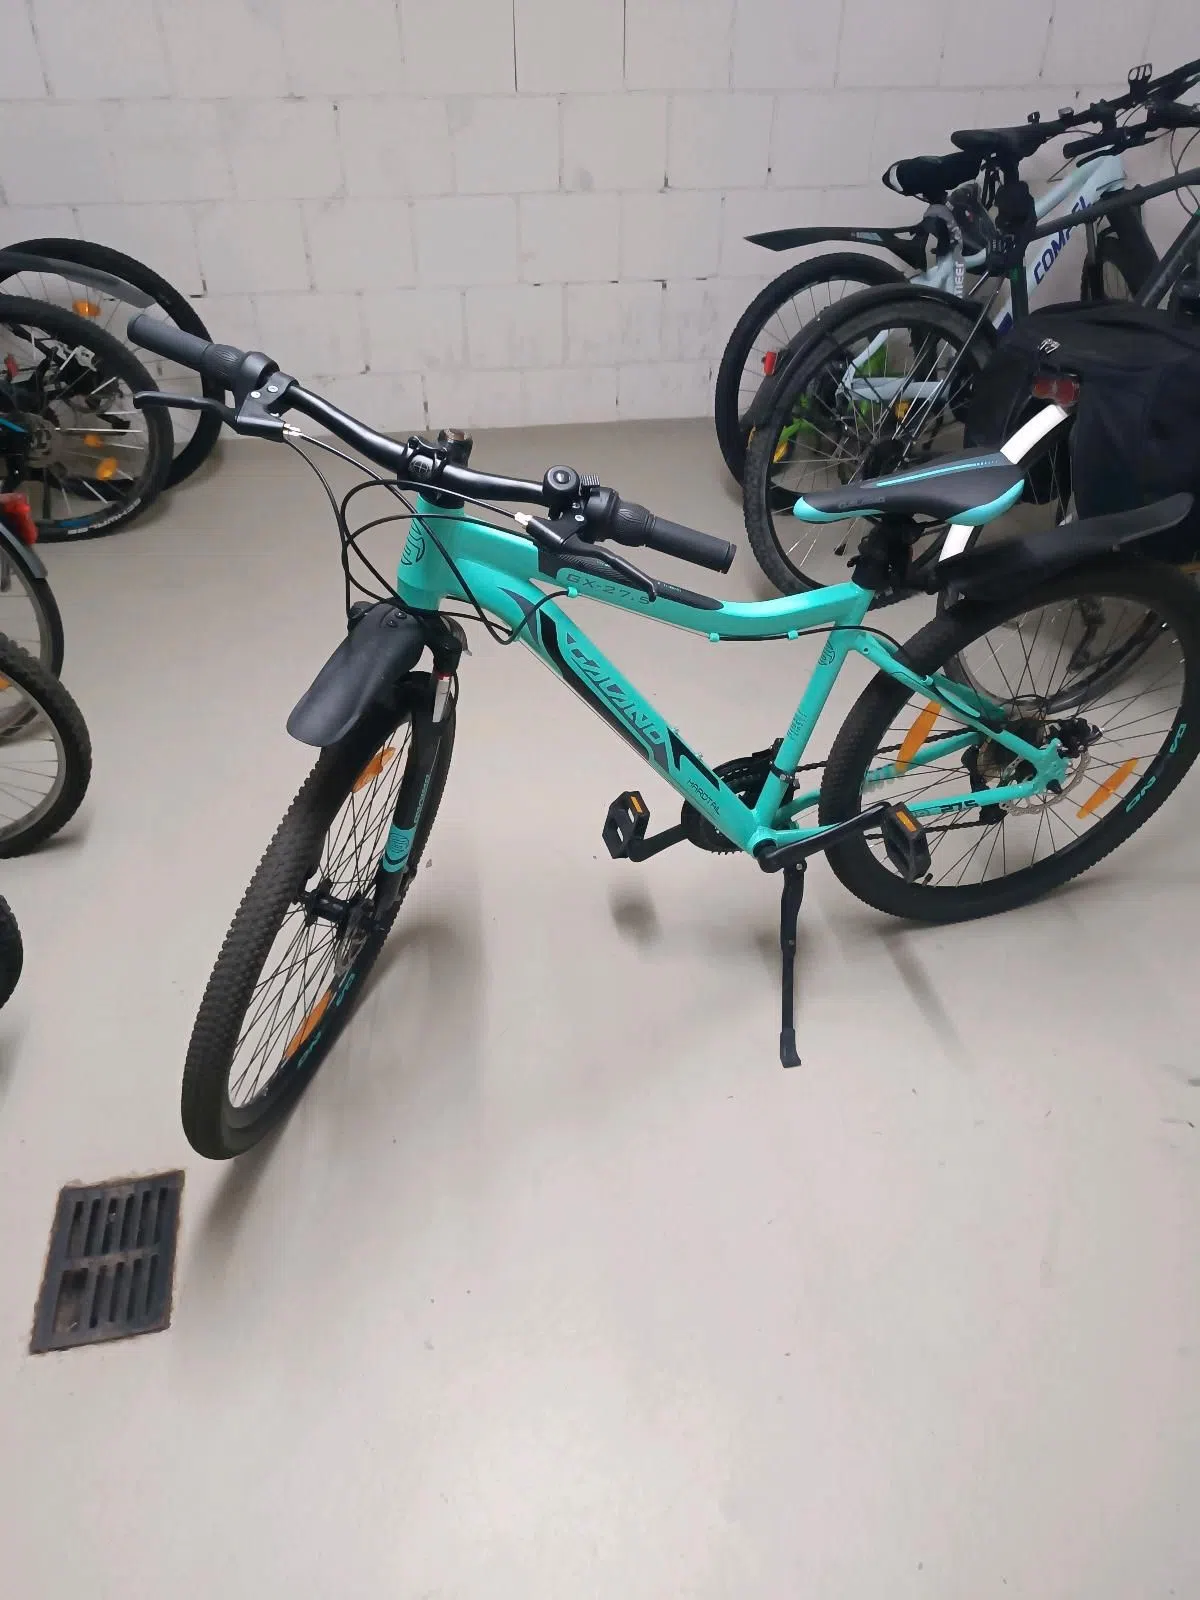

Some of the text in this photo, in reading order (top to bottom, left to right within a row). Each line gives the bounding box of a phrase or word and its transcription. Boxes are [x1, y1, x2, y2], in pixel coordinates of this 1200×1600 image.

[1033, 195, 1092, 285] COML
[568, 644, 667, 746] GALANO
[687, 778, 720, 817] HARDTAIL
